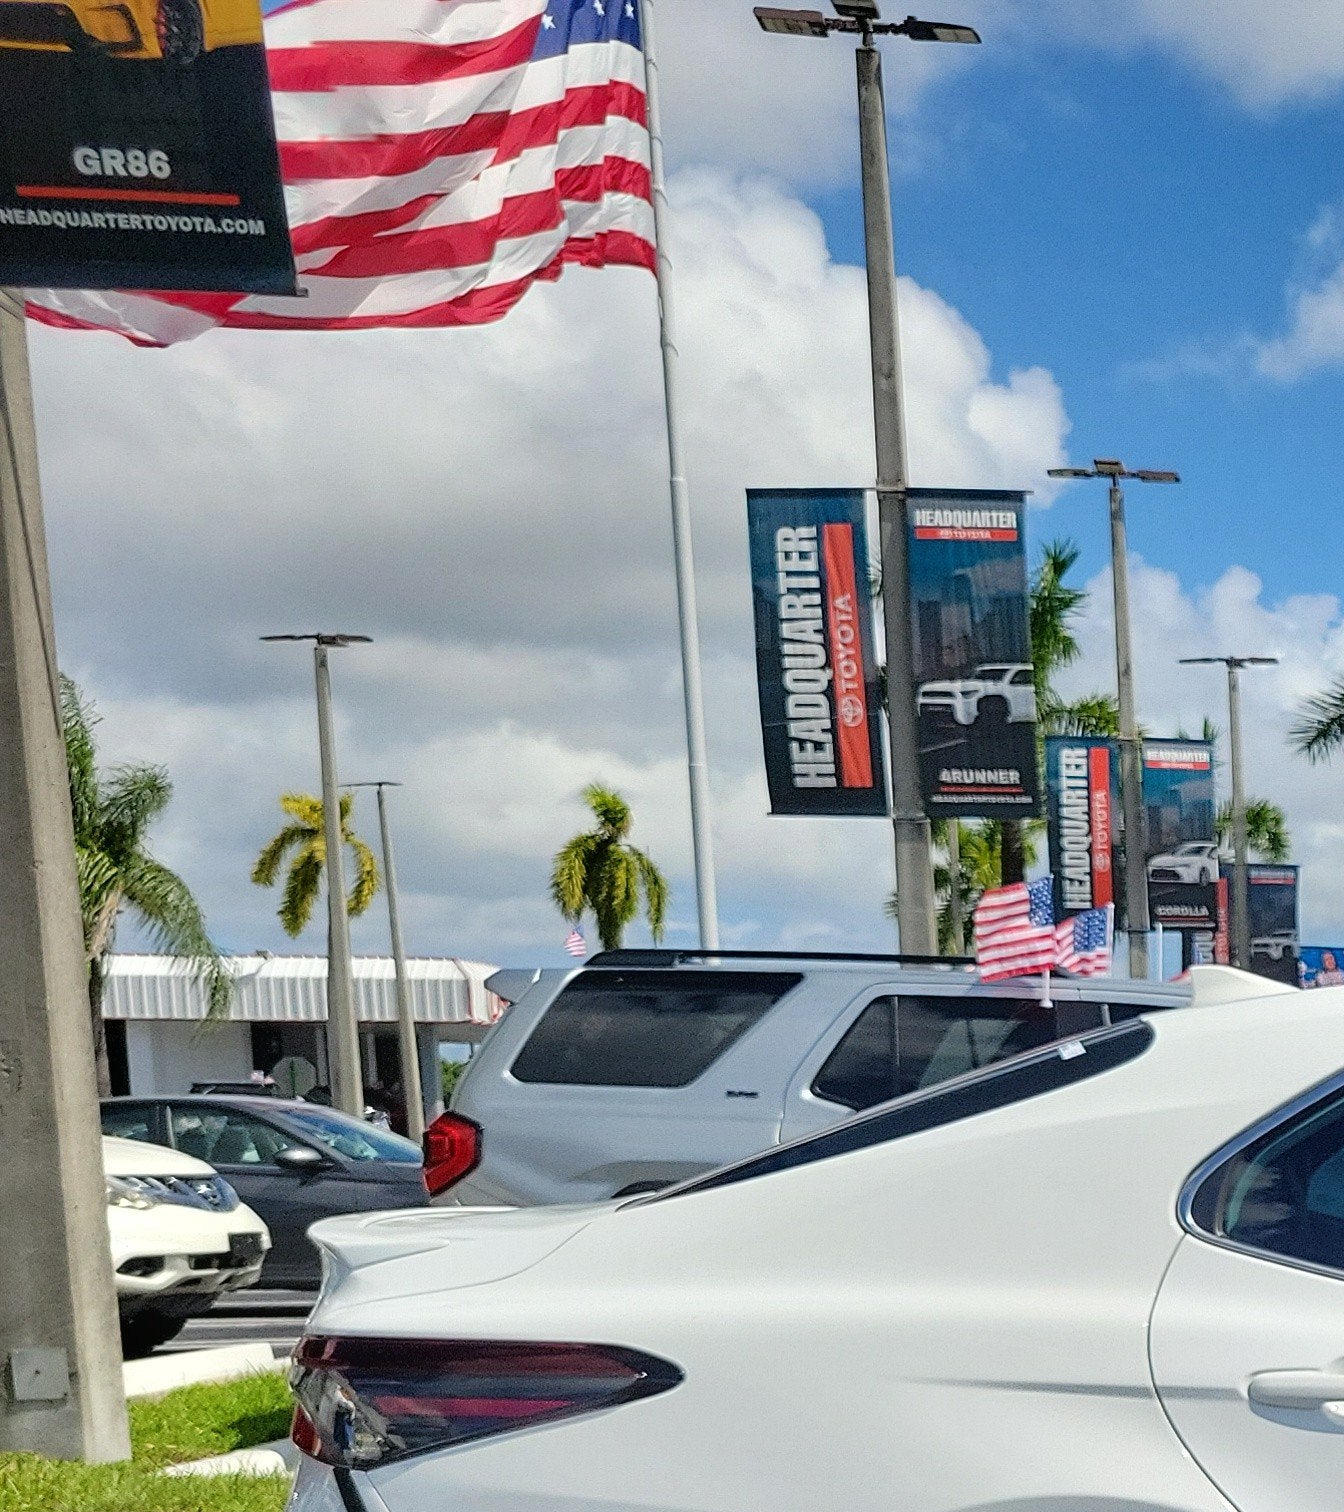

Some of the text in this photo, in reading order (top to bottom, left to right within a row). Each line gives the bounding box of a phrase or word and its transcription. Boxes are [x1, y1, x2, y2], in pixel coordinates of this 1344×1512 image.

[73, 147, 171, 180] GR86
[0, 208, 265, 236] HEADQUARTERTOYOTA.COM
[915, 510, 1017, 528] HEADQUARTER
[775, 525, 837, 788] HEADQUARTER
[835, 594, 860, 691] TOYOTA
[940, 768, 1020, 784] 4RUNNER
[1058, 748, 1092, 909] HEADQUARTER
